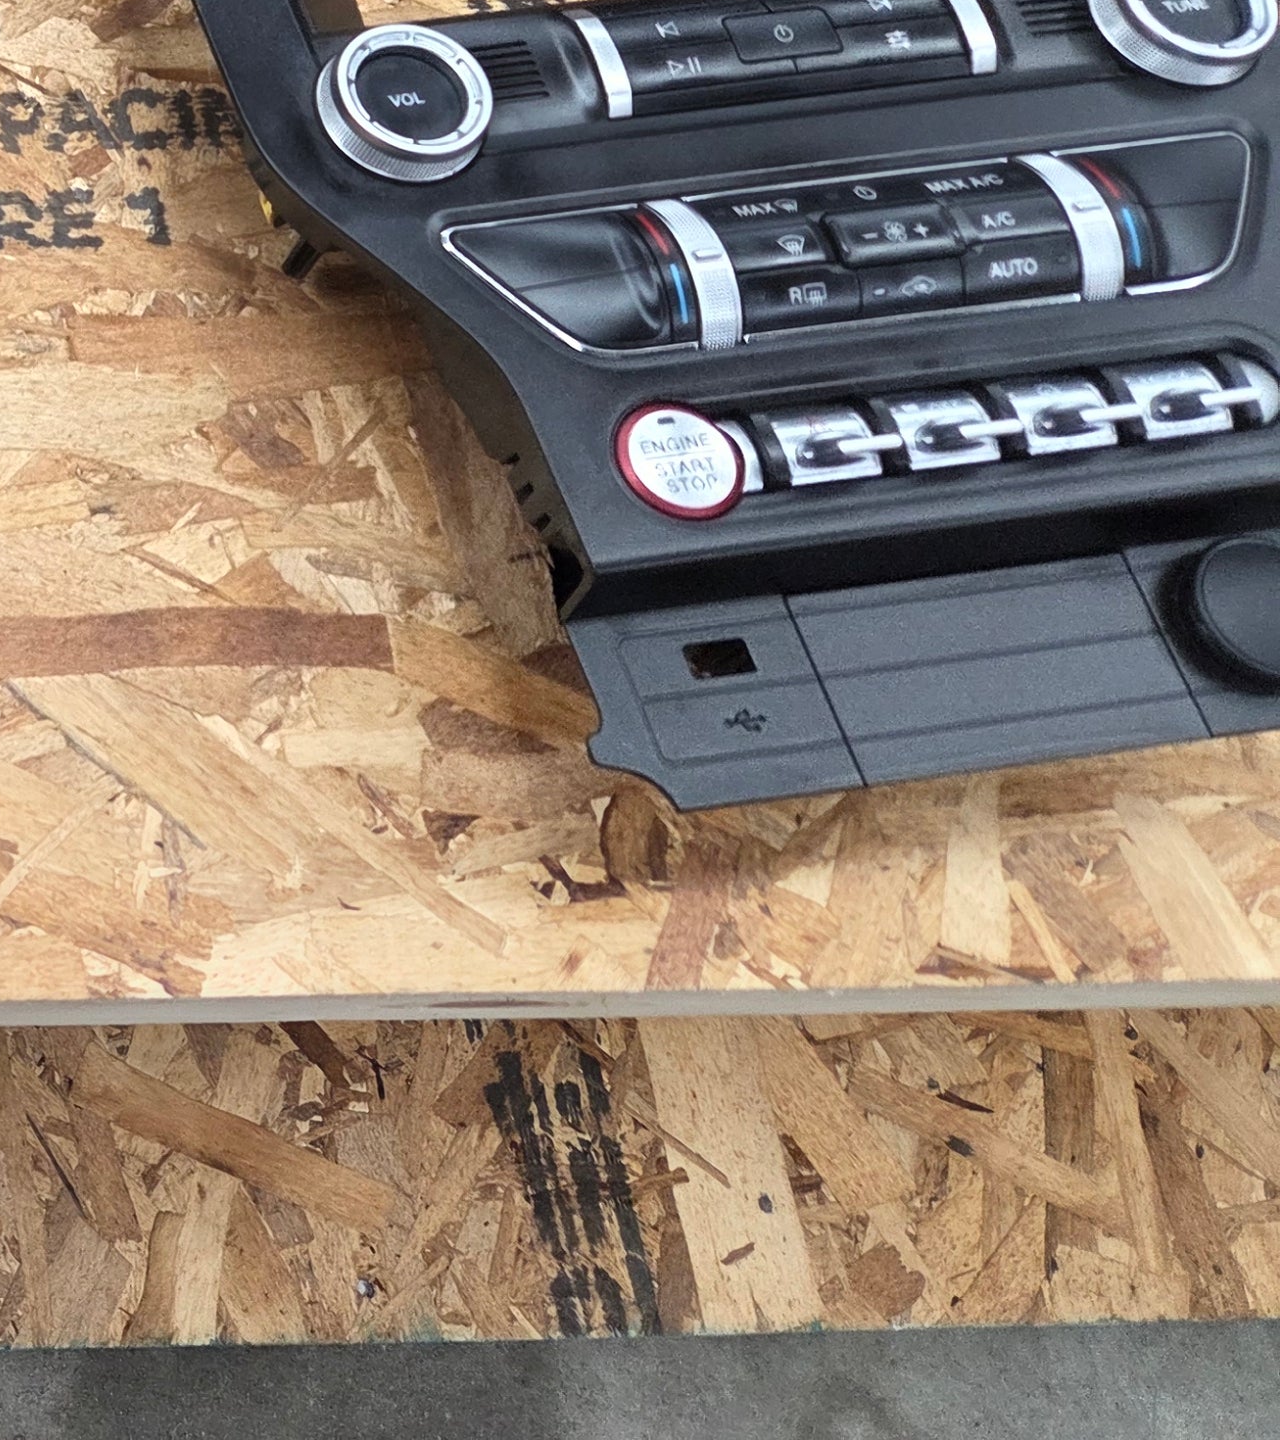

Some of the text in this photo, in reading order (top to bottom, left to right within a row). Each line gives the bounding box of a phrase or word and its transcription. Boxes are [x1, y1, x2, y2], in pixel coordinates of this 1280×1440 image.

[387, 91, 426, 108] VOL
[923, 173, 1004, 194] MAX A/C
[125, 185, 172, 247] 1
[731, 201, 777, 218] MAX
[981, 211, 1016, 229] A/C
[989, 257, 1039, 279] AUTO
[789, 287, 803, 305] R
[640, 433, 710, 455] ENGINE
[655, 456, 717, 477] START
[666, 473, 718, 494] STOP
